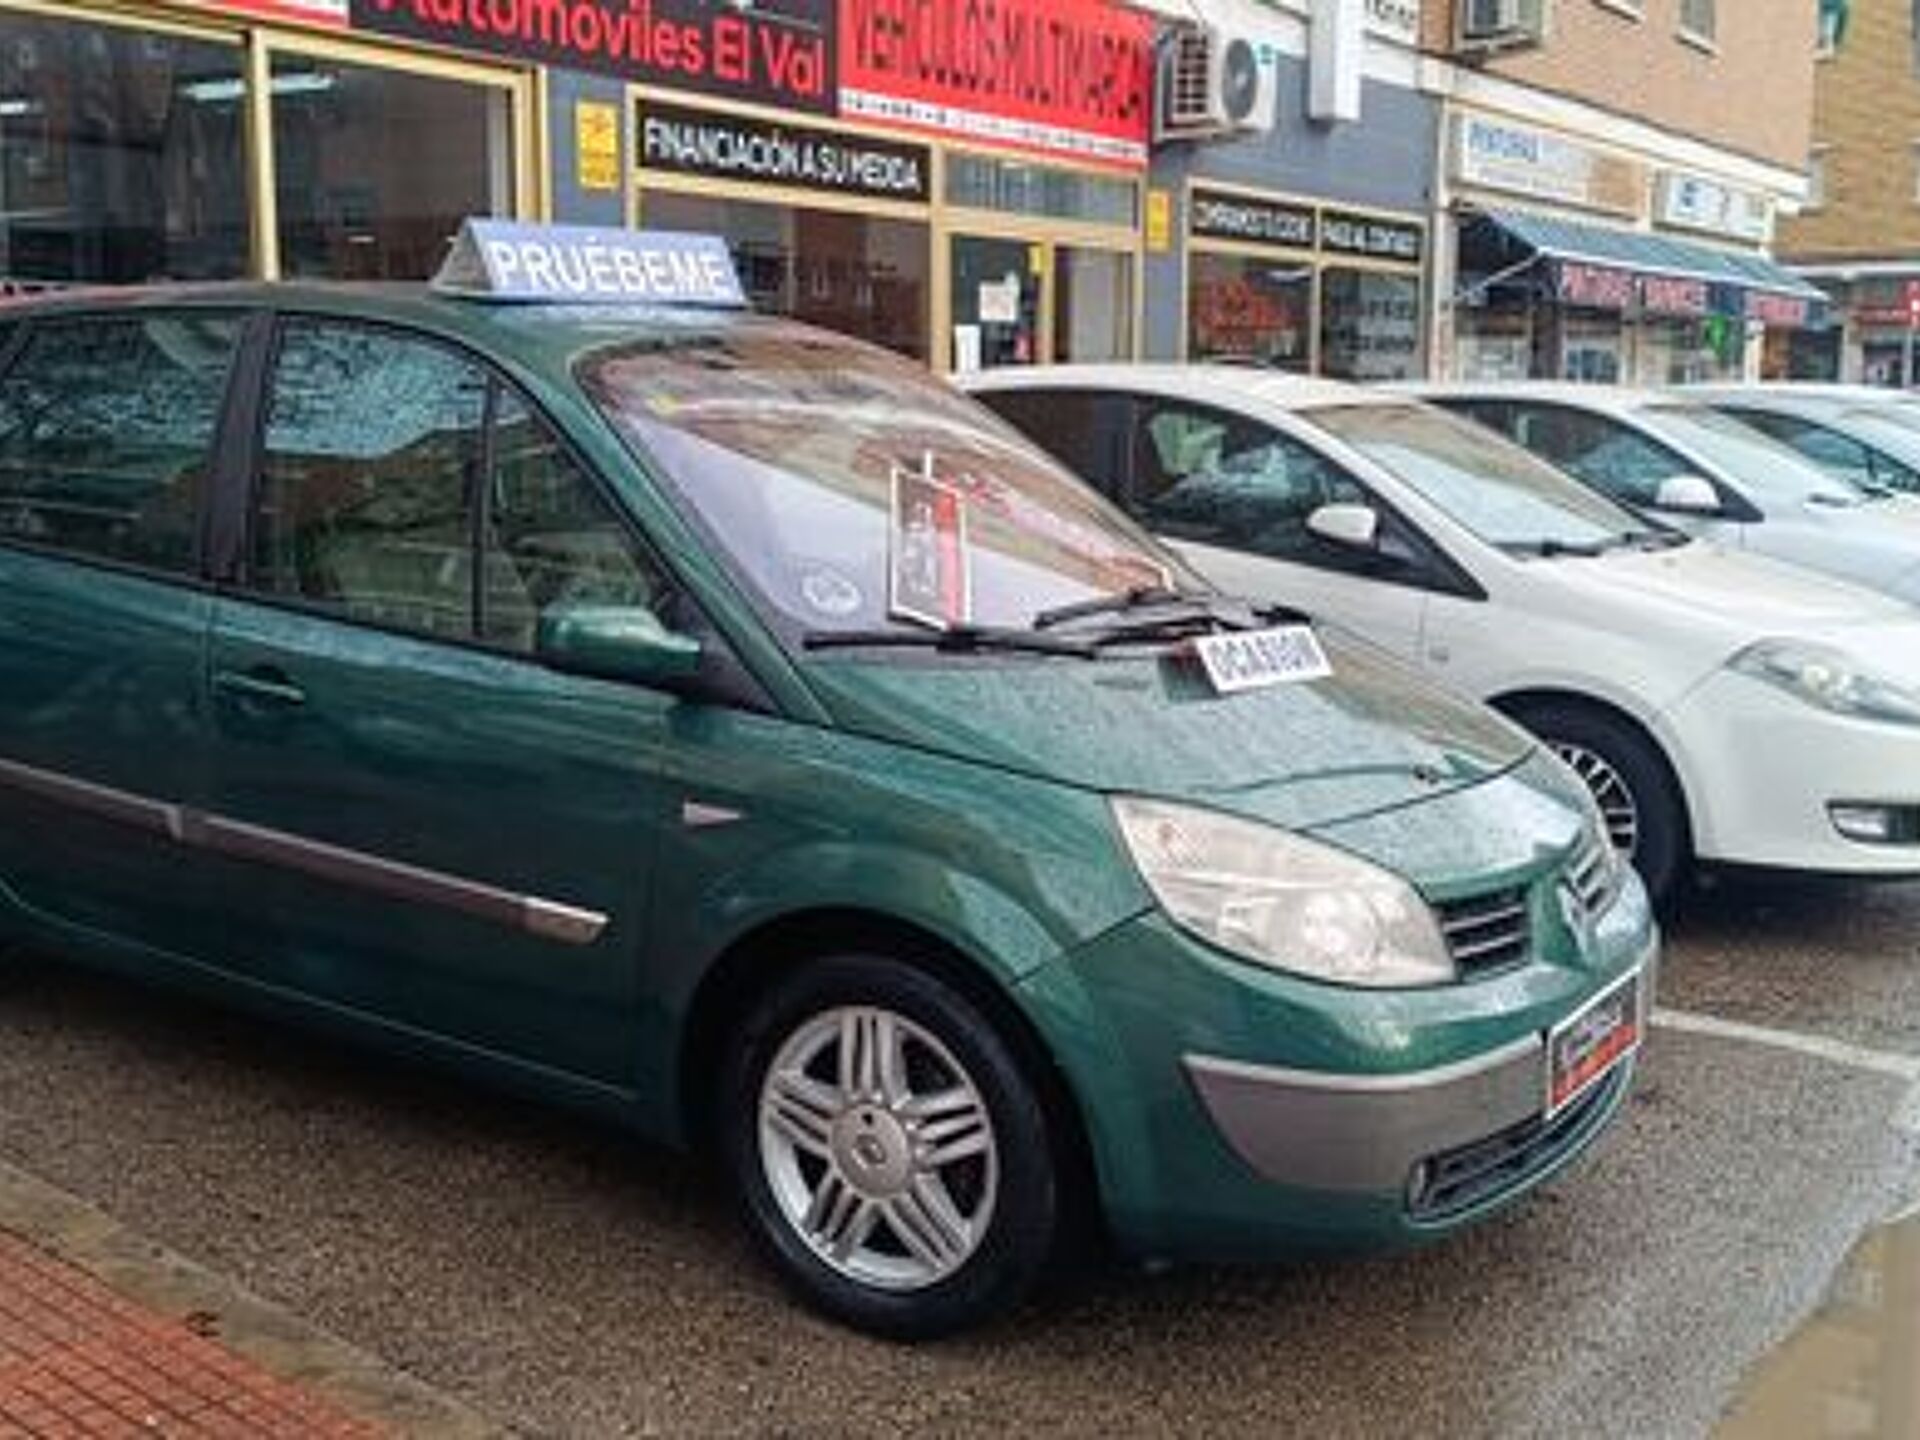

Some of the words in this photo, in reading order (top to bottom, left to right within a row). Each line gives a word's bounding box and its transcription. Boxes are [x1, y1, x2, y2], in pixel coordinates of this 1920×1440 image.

[712, 18, 751, 82] El
[761, 29, 826, 95] Val
[485, 234, 731, 296] PRUÉBEME
